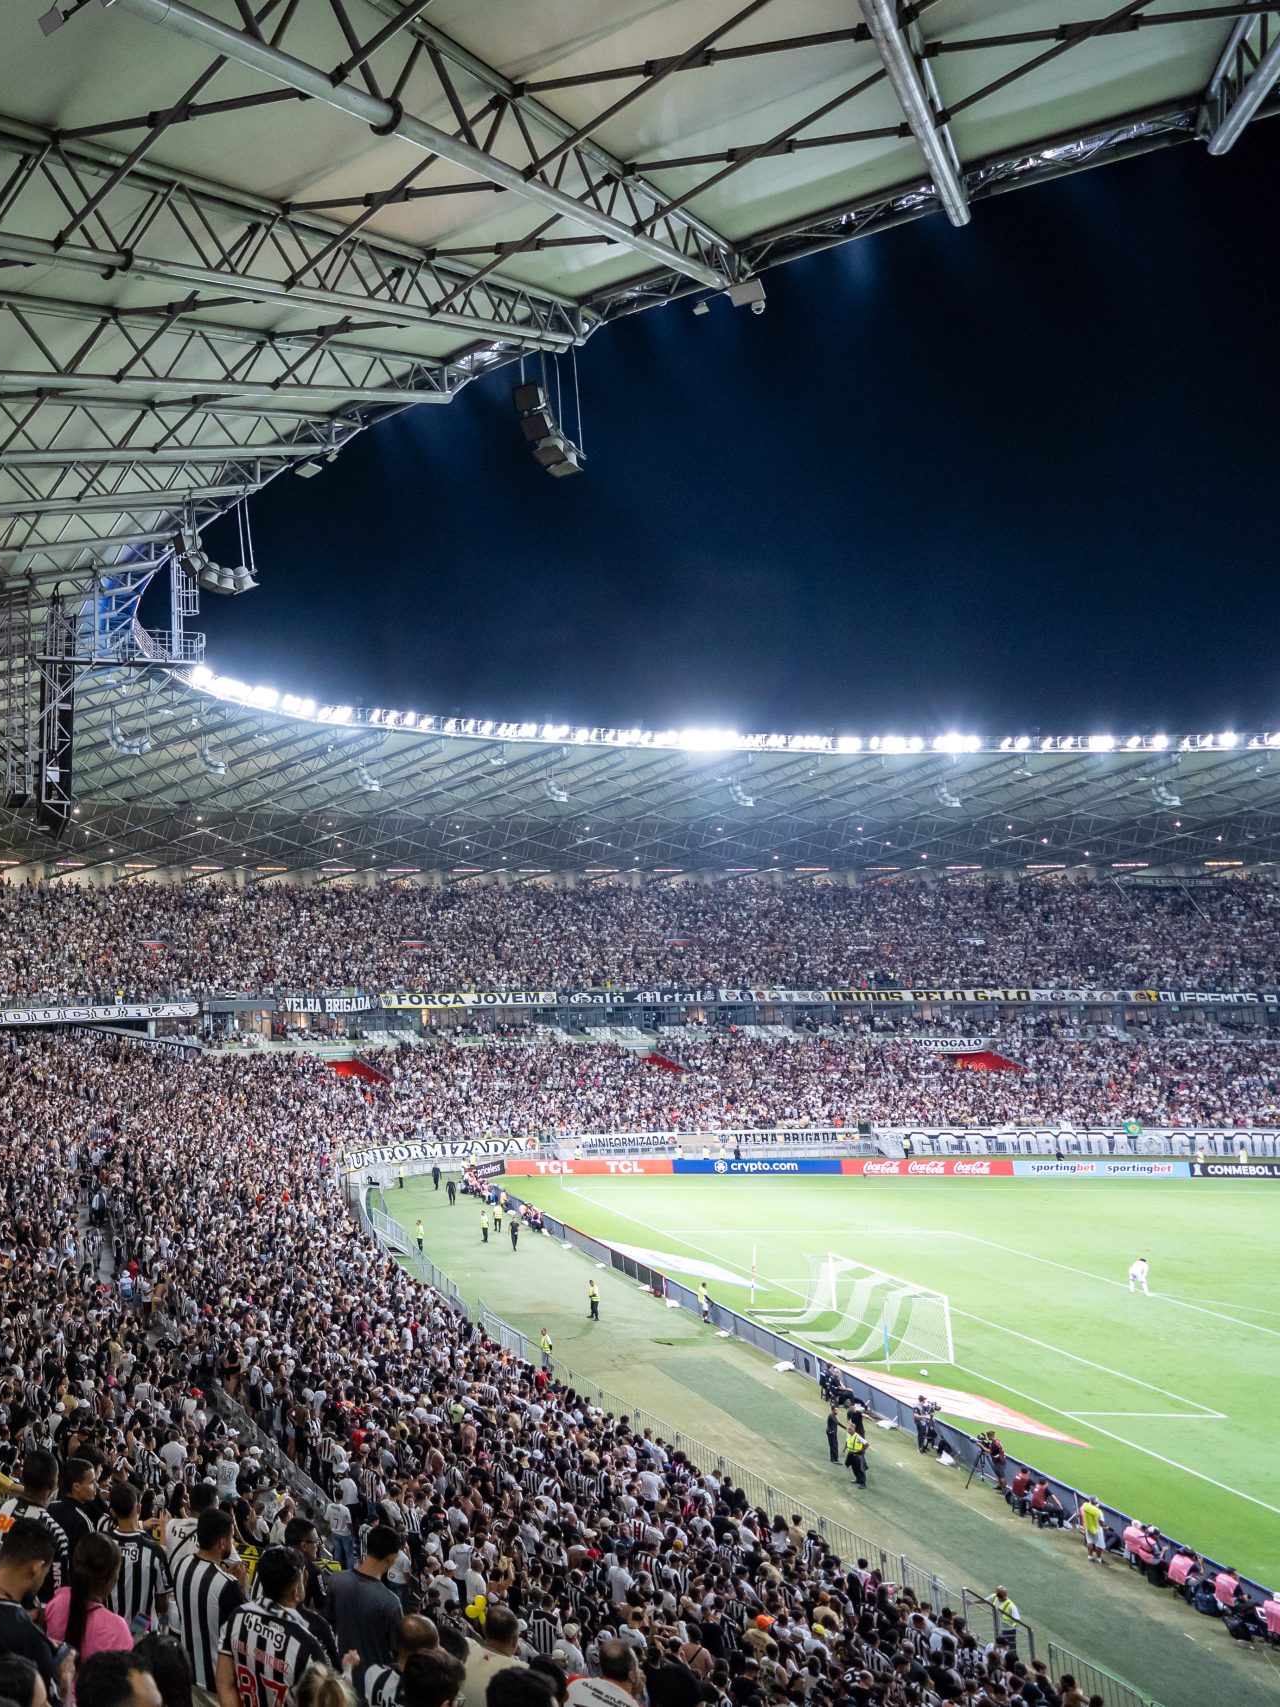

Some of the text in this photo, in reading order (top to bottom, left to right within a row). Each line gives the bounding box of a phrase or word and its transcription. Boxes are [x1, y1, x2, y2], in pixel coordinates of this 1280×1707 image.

[397, 992, 540, 1007] FORÇA JOVEM
[634, 990, 704, 1003] Metal
[911, 991, 966, 1001] PELO
[1159, 992, 1258, 1003] QUEREMOS
[285, 996, 370, 1013] VELHA BRIGADA
[913, 1038, 982, 1048] MOTOGALO
[589, 1137, 666, 1148] UNIFORMIZADA
[736, 1131, 838, 1144] VELHA BRIGADA
[351, 1139, 526, 1168] UNIFORMIZADA
[477, 1164, 501, 1178] priceless
[536, 1161, 573, 1174] TCL
[606, 1160, 644, 1174] TCL
[730, 1161, 799, 1172] crypto.com
[1031, 1163, 1096, 1173] sportingbet
[1107, 1164, 1173, 1174] sportingbet
[1207, 1164, 1267, 1176] CONMEBOL
[253, 1618, 284, 1649] bmg
